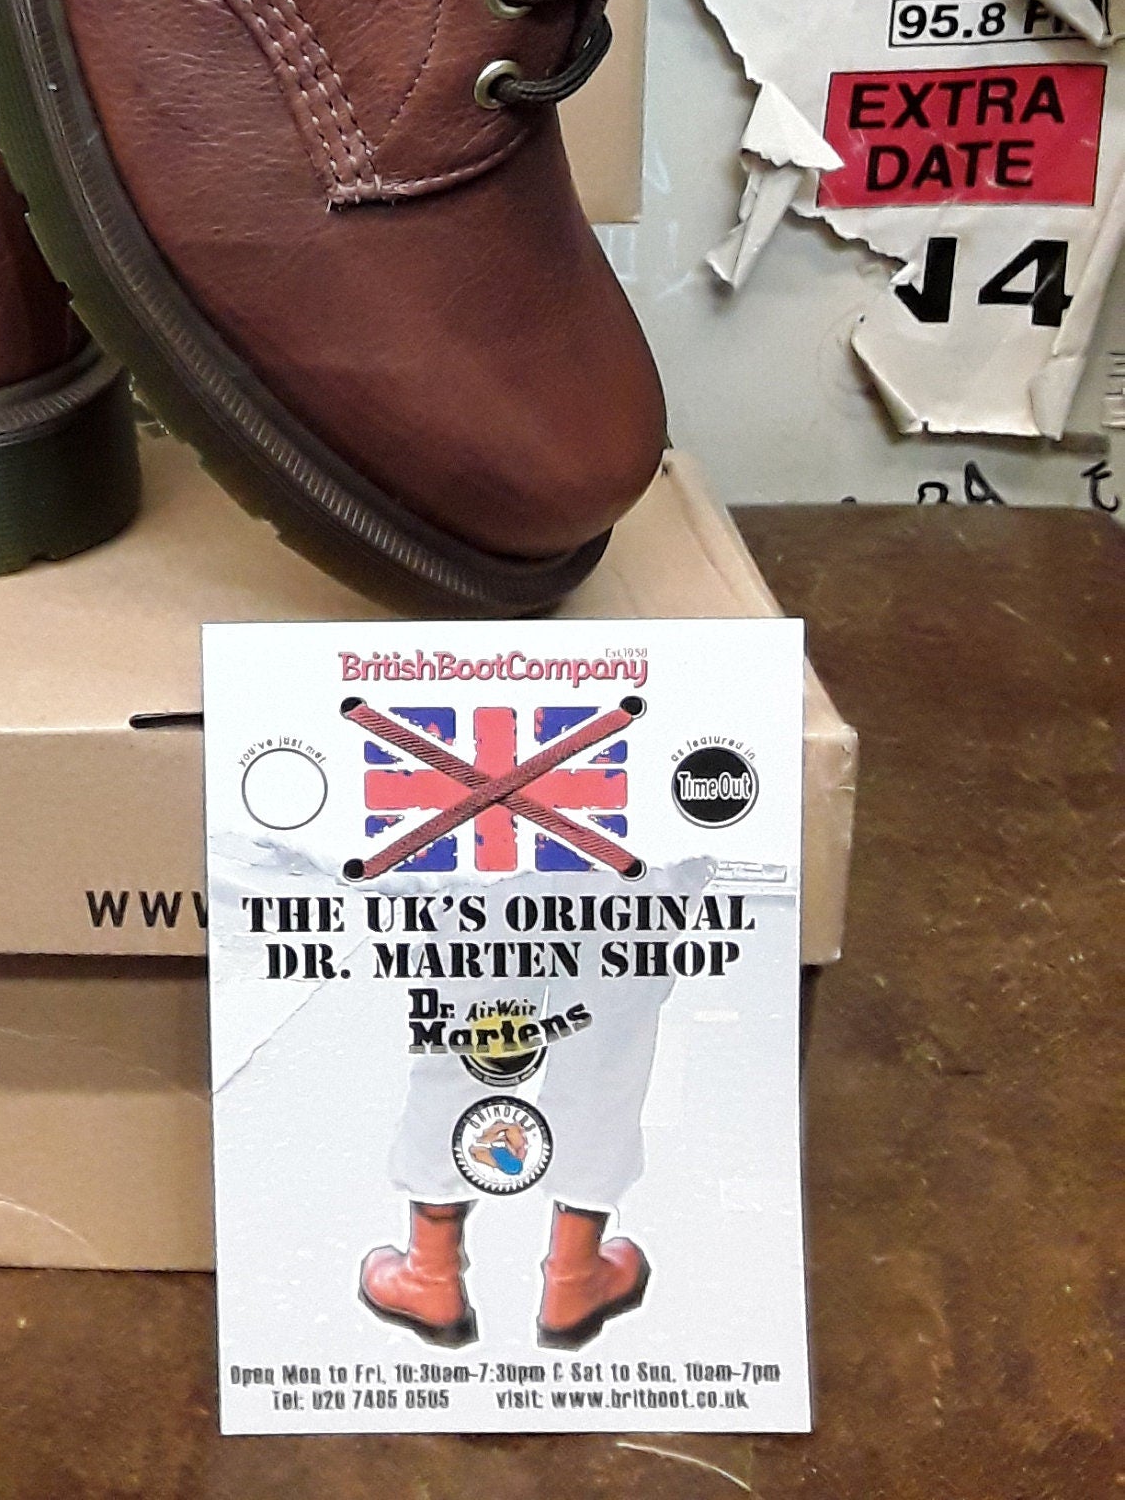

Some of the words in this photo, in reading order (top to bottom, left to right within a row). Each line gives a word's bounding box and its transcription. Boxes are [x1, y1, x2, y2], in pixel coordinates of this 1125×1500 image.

[898, 2, 1006, 39] 95.8
[848, 75, 1065, 131] EXTRA
[865, 140, 1035, 192] DATE
[338, 650, 649, 689] BritishBootCompany
[242, 897, 345, 933] THE
[364, 896, 486, 933] UK'S
[505, 895, 755, 932] ORIGINAL
[265, 943, 352, 979] DR.
[372, 941, 582, 978] MARTEN
[601, 940, 740, 977] SHOP
[408, 988, 456, 1019] Dr.
[408, 1003, 593, 1053] Martens
[230, 1364, 274, 1387] Open
[282, 1364, 321, 1385] Mon
[329, 1364, 347, 1384] to
[570, 1362, 603, 1382] Sat
[611, 1362, 630, 1382] to
[683, 1361, 781, 1385] 10am-7pm
[272, 1389, 305, 1410] Tel:
[496, 1389, 543, 1410] visit:
[551, 1388, 749, 1409] www.britboot.co.uk
